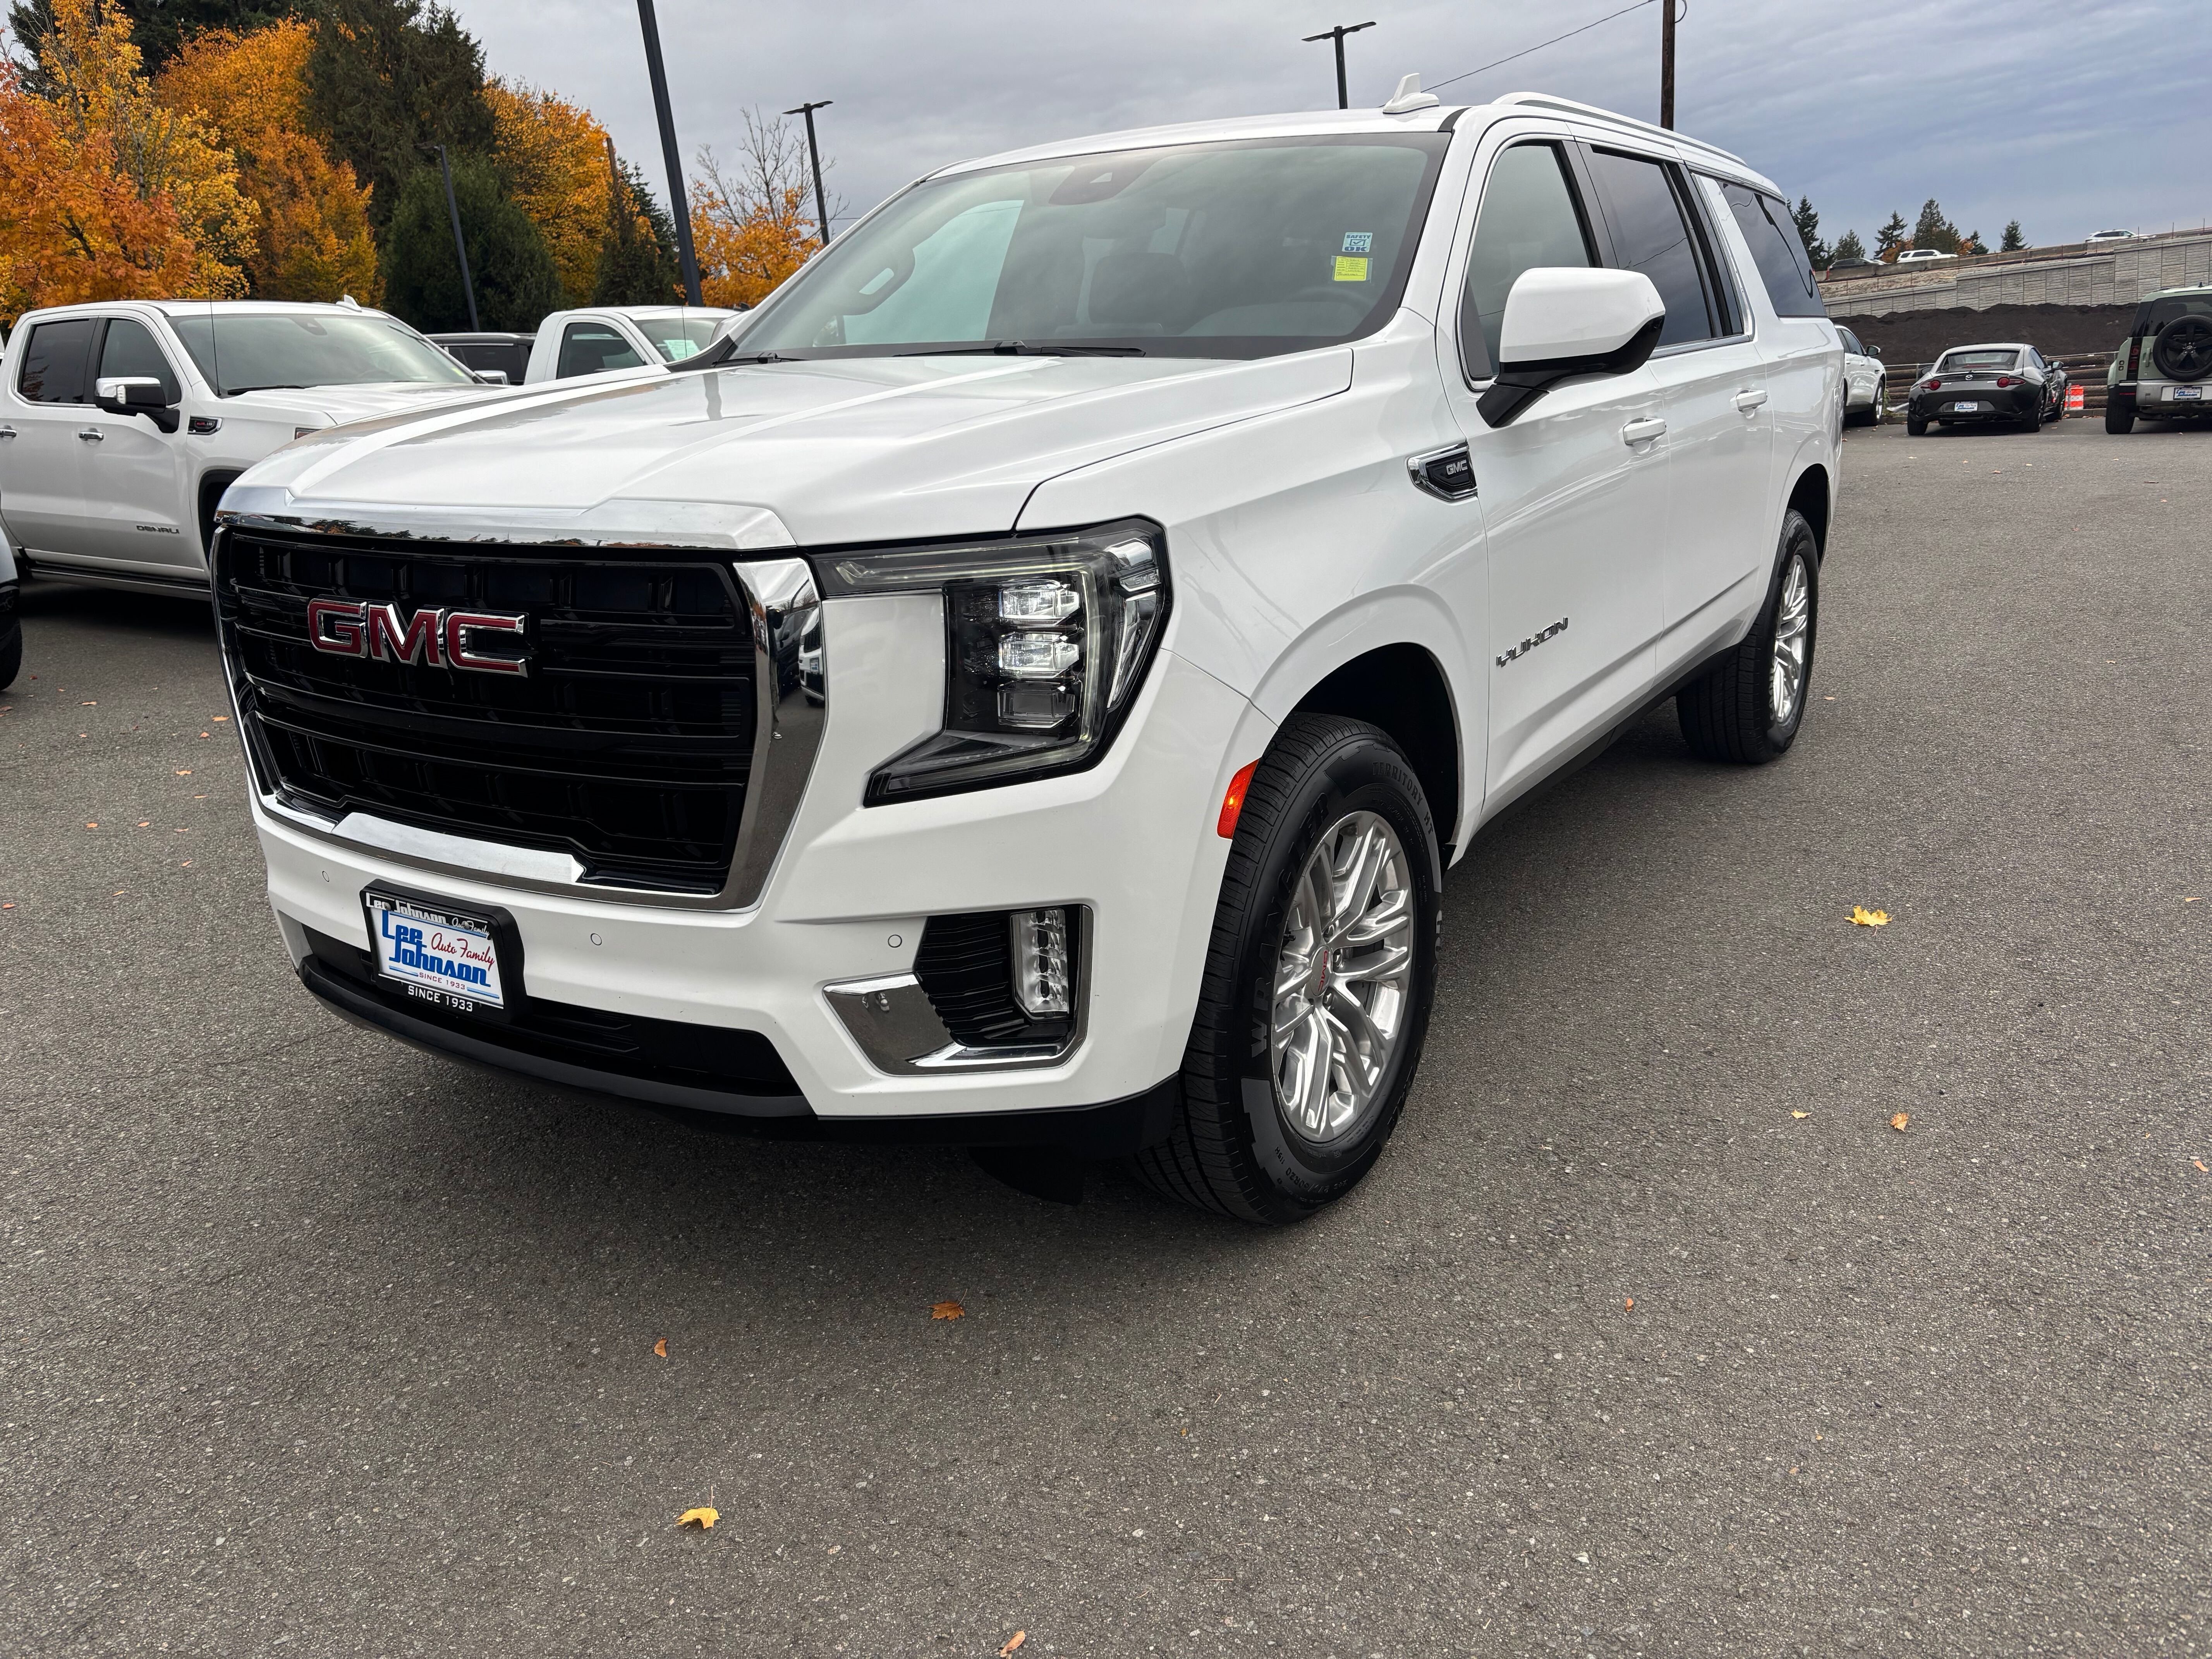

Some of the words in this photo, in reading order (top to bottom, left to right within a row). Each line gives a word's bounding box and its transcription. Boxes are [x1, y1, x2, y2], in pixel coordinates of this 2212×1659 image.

[1446, 460, 1468, 475] GMC
[136, 525, 180, 534] DENALI
[308, 598, 527, 678] GMC
[1496, 617, 1568, 668] YUKON
[1372, 761, 1423, 806] TERRITORY
[1424, 811, 1433, 835] HT
[382, 910, 423, 944] Lee
[394, 899, 449, 926] Johnson
[466, 920, 489, 939] Family
[1251, 792, 1329, 1050] WRANGLER
[389, 940, 491, 987] Johnson
[431, 933, 457, 954] Auto
[456, 938, 495, 971] Family
[1317, 950, 1328, 992] GMC
[408, 985, 440, 1003] SINCE
[445, 996, 473, 1012] 1933
[419, 972, 443, 984] SINCE
[446, 979, 465, 990] 1933
